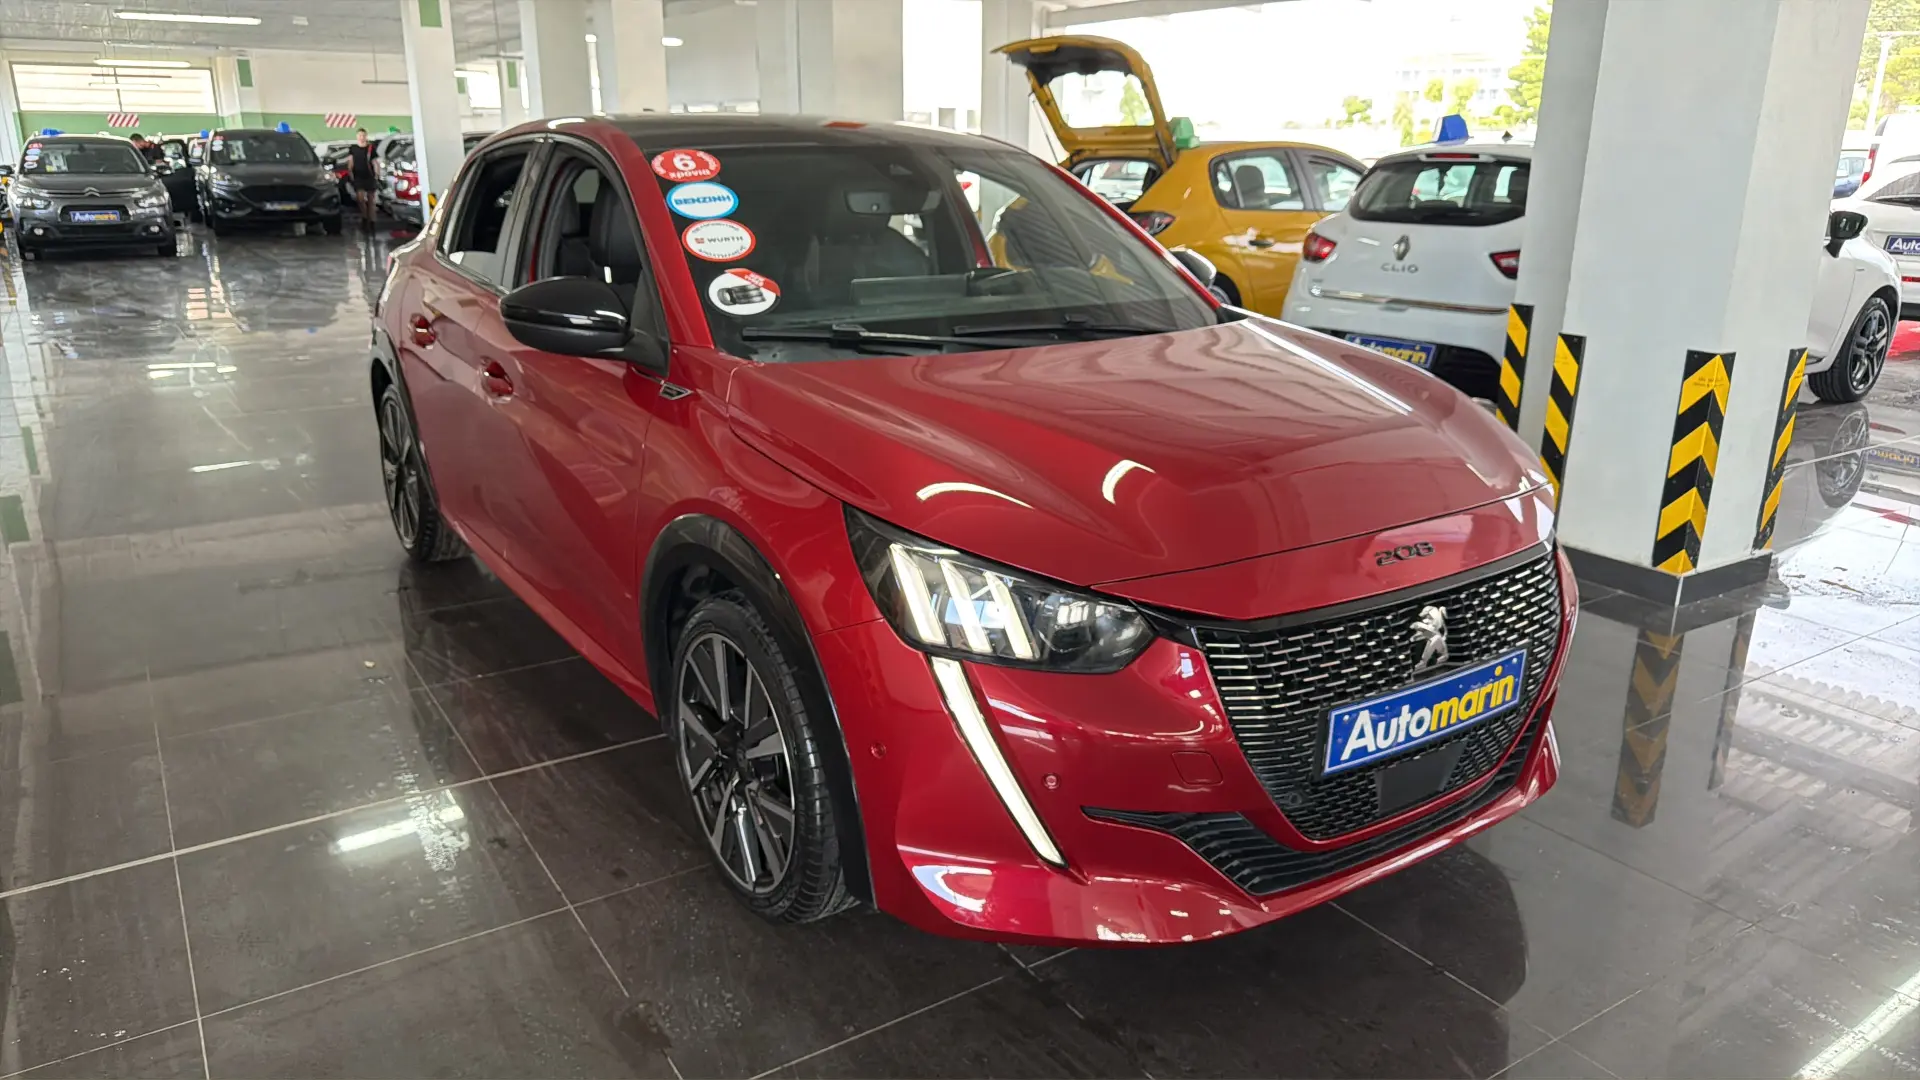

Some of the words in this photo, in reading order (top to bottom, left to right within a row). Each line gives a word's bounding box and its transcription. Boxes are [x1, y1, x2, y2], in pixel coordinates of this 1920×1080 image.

[673, 152, 697, 171] 6
[1380, 262, 1419, 274] CLIO
[1340, 665, 1515, 761] Automarin
